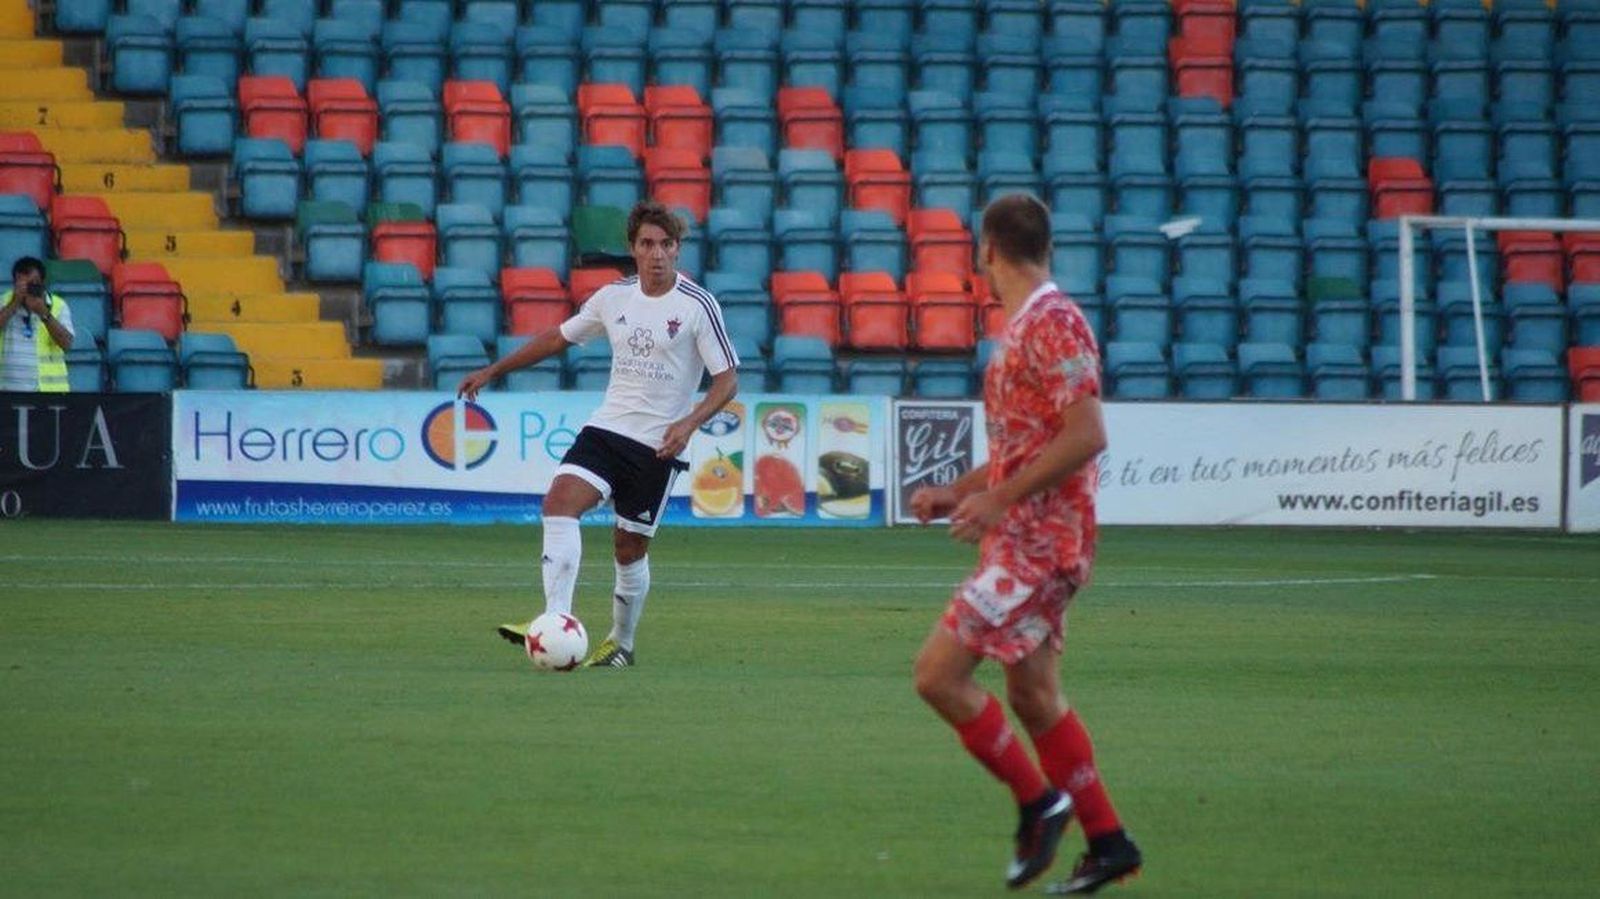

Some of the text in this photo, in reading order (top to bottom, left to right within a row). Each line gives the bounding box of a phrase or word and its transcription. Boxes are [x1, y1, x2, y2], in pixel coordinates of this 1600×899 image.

[38, 107, 48, 125] 7
[104, 172, 115, 189] 6
[165, 234, 177, 252] 5
[231, 300, 242, 317] 4
[901, 409, 959, 420] CONFITERIA
[0, 404, 125, 470] UA
[194, 410, 576, 462] Herrero Pé
[905, 416, 971, 474] Gil
[1150, 465, 1182, 485] en
[1191, 456, 1237, 482] tus
[1243, 446, 1380, 478] momentos
[1387, 440, 1448, 470] más
[1450, 429, 1543, 482] felices
[933, 464, 958, 486] 60
[194, 495, 453, 518] www.frutasherreroperez.es
[1278, 491, 1540, 518] www.confiteriagil.es
